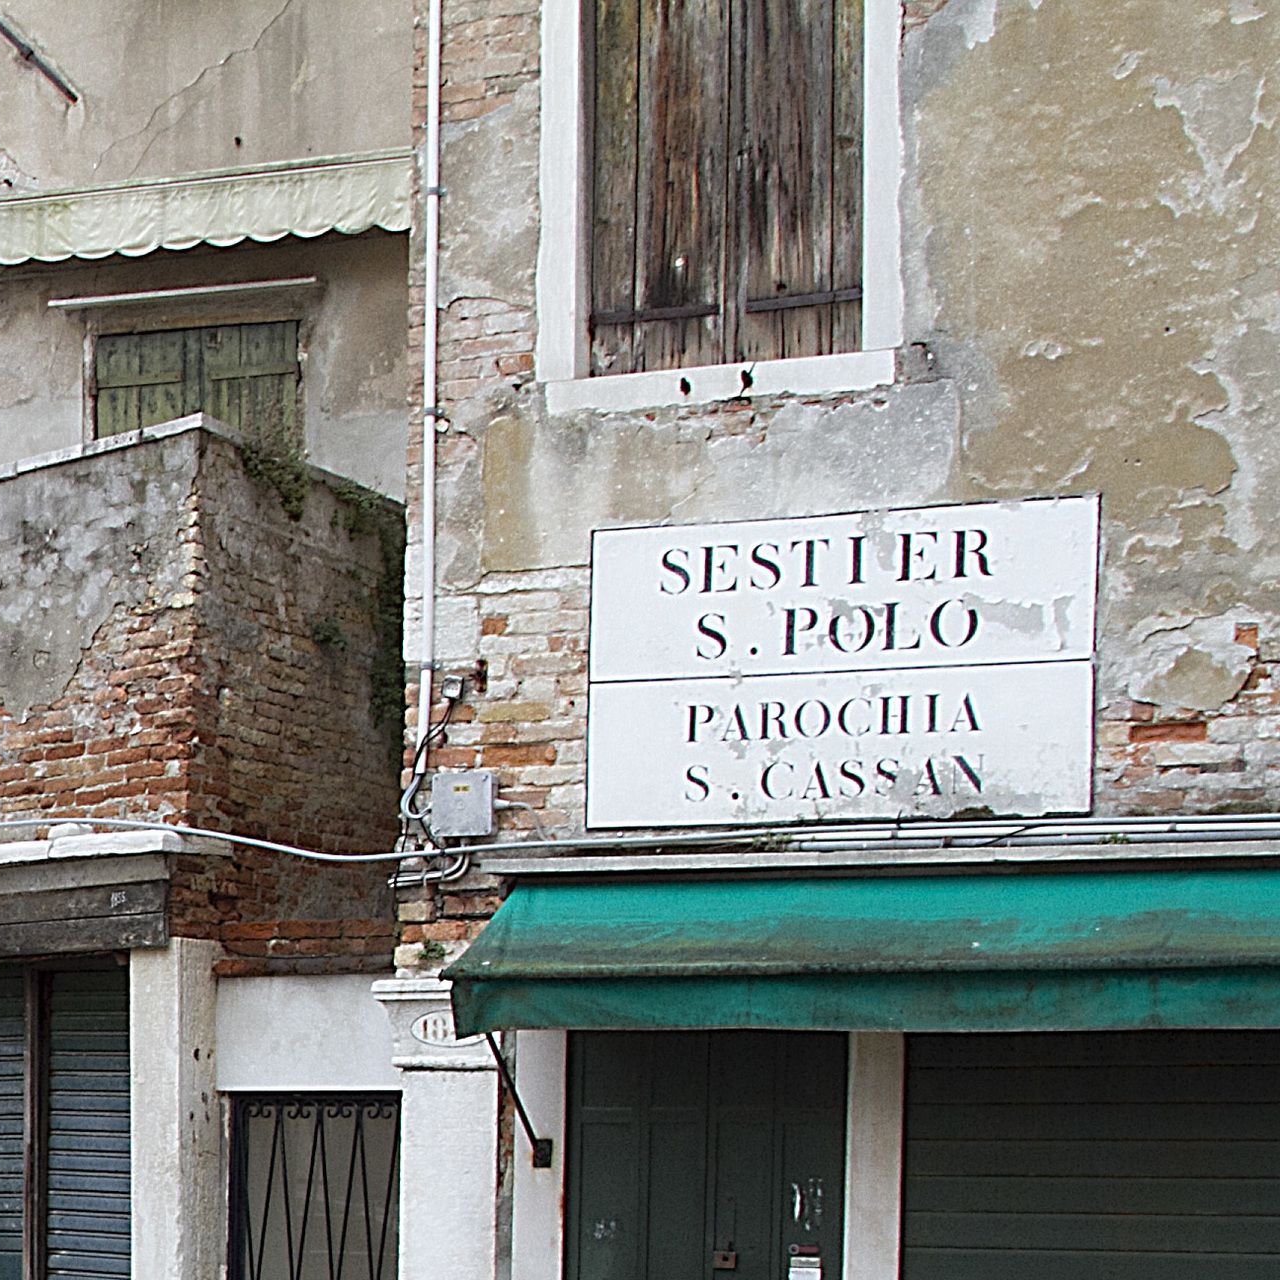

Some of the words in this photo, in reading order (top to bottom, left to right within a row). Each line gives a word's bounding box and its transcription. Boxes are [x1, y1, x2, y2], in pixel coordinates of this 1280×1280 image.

[659, 527, 994, 596] SESTIER
[685, 692, 983, 744] PAROCHIA
[422, 1015, 454, 1041] 18
